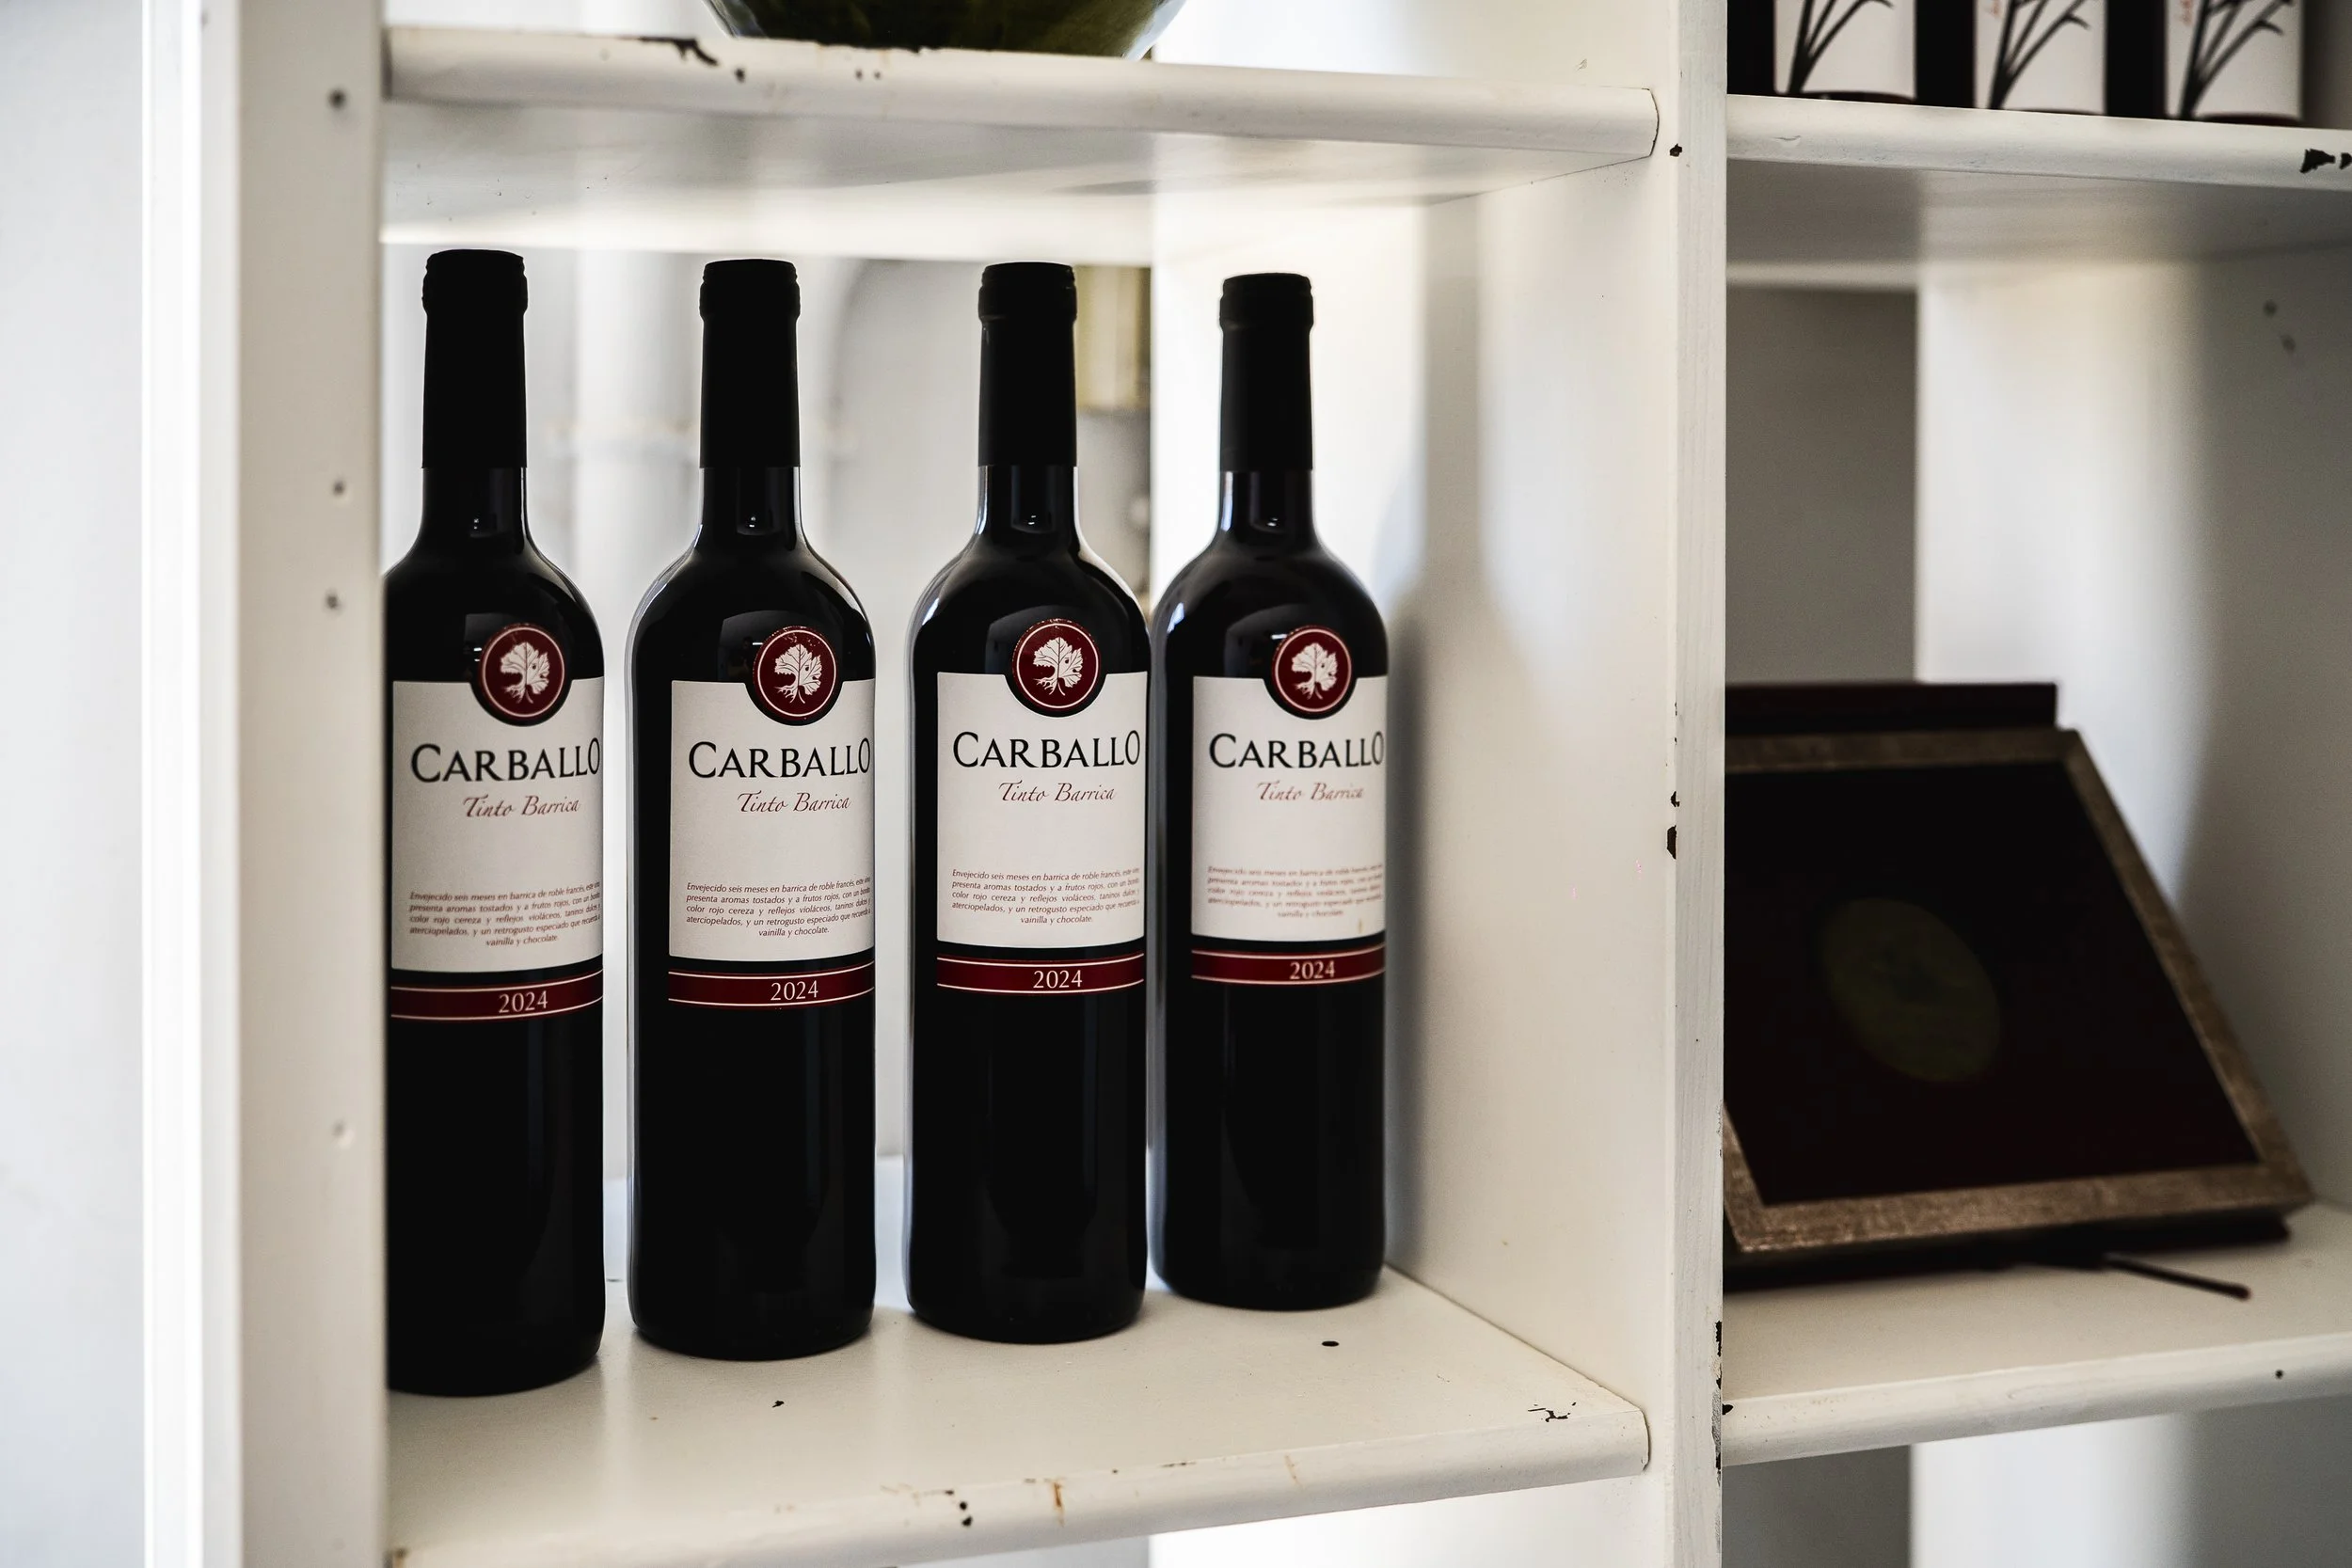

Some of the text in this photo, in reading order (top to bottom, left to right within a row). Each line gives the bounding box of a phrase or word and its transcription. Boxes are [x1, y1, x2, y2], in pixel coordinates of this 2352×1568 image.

[953, 730, 1140, 768] CARBALLO
[1210, 731, 1384, 768] CARBALLO
[411, 737, 600, 783] CARBALLO
[689, 737, 871, 779] CARBALLO
[998, 780, 1116, 802] Tinto Barrica
[1257, 780, 1364, 800] Tinto Barrica
[463, 794, 580, 817] Tinto Barrica
[738, 790, 850, 813] Tinto Barrica
[952, 869, 990, 879] Envejecido
[1082, 871, 1099, 879] roble
[687, 882, 727, 893] Envejecido
[809, 883, 818, 892] de
[818, 881, 835, 891] roble
[952, 881, 981, 890] presenta
[1014, 883, 1047, 892] tostados
[453, 893, 469, 901] seis
[510, 891, 536, 900] barrica
[537, 890, 547, 898] de
[686, 895, 718, 903] presenta
[753, 895, 785, 904] tostados
[803, 895, 822, 903] frutos
[824, 894, 840, 902] rojos,
[972, 893, 987, 901] rojo
[1021, 895, 1025, 904] y
[1029, 894, 1057, 904] reflejos
[408, 904, 443, 913] presenta
[708, 906, 724, 915] rojo
[768, 907, 795, 916] reflejos
[834, 901, 854, 911] taninos
[1008, 906, 1013, 914] y
[1028, 905, 1067, 914] retrogusto
[1070, 903, 1104, 914] especiado
[1104, 902, 1116, 911] que
[409, 914, 429, 923] color
[433, 916, 450, 926] rojo
[486, 917, 491, 926] y
[686, 916, 743, 927] aterciopelados,
[746, 919, 751, 927] y
[766, 917, 804, 927] retrogusto
[806, 913, 839, 925] especiado
[840, 912, 850, 921] que
[1021, 915, 1047, 924] vainilla
[1050, 917, 1055, 926] y
[494, 926, 533, 935] retrogusto
[535, 921, 569, 932] especiado
[758, 927, 829, 938] vainilla y chocolate.
[485, 937, 514, 946] vainilla
[1289, 959, 1336, 980] 2024
[1033, 970, 1083, 989] 2024
[771, 980, 818, 1001] 2024
[499, 990, 548, 1013] 2024
